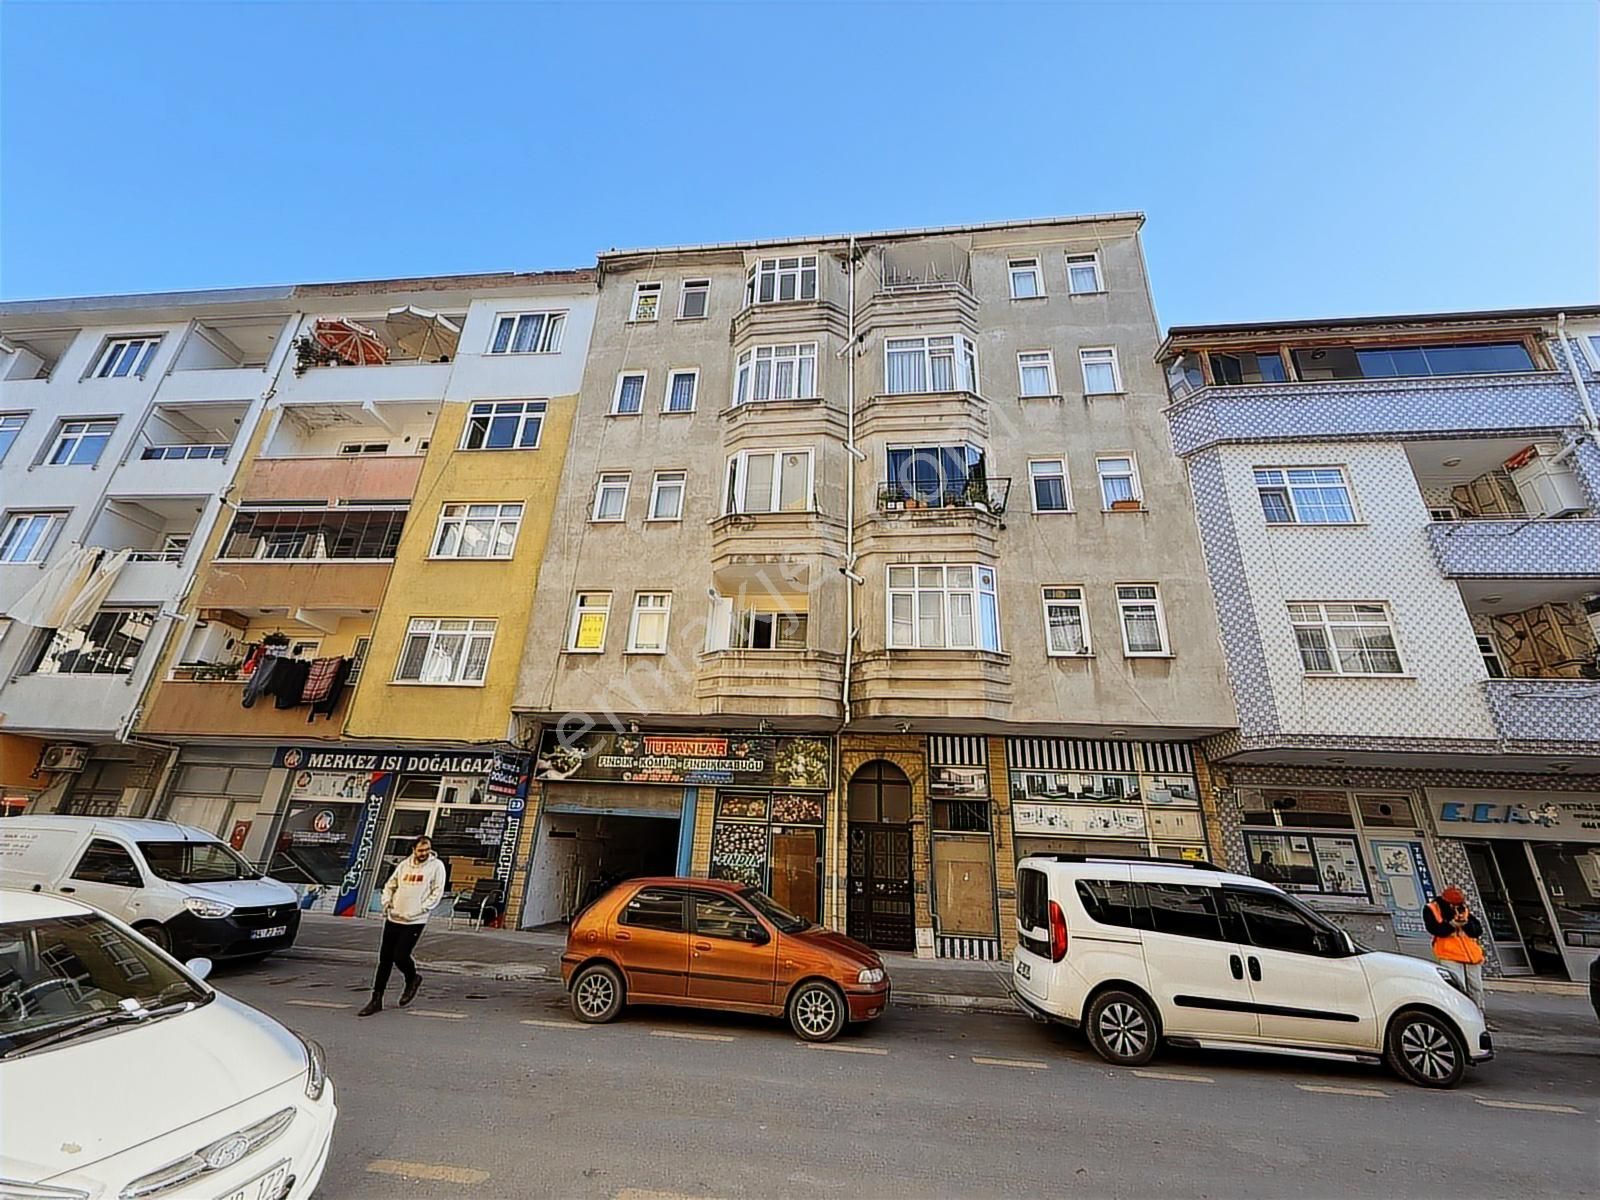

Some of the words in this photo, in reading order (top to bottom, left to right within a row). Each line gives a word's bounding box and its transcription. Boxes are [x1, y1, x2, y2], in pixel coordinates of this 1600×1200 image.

[643, 736, 729, 757] TURANLAR
[308, 753, 377, 769] MERKEZ
[380, 755, 401, 770] ISI
[407, 753, 494, 773] DOĞALGAZ
[598, 756, 633, 768] FINDIK
[639, 755, 677, 769] KÖMÜR
[716, 852, 762, 867] FINDIK
